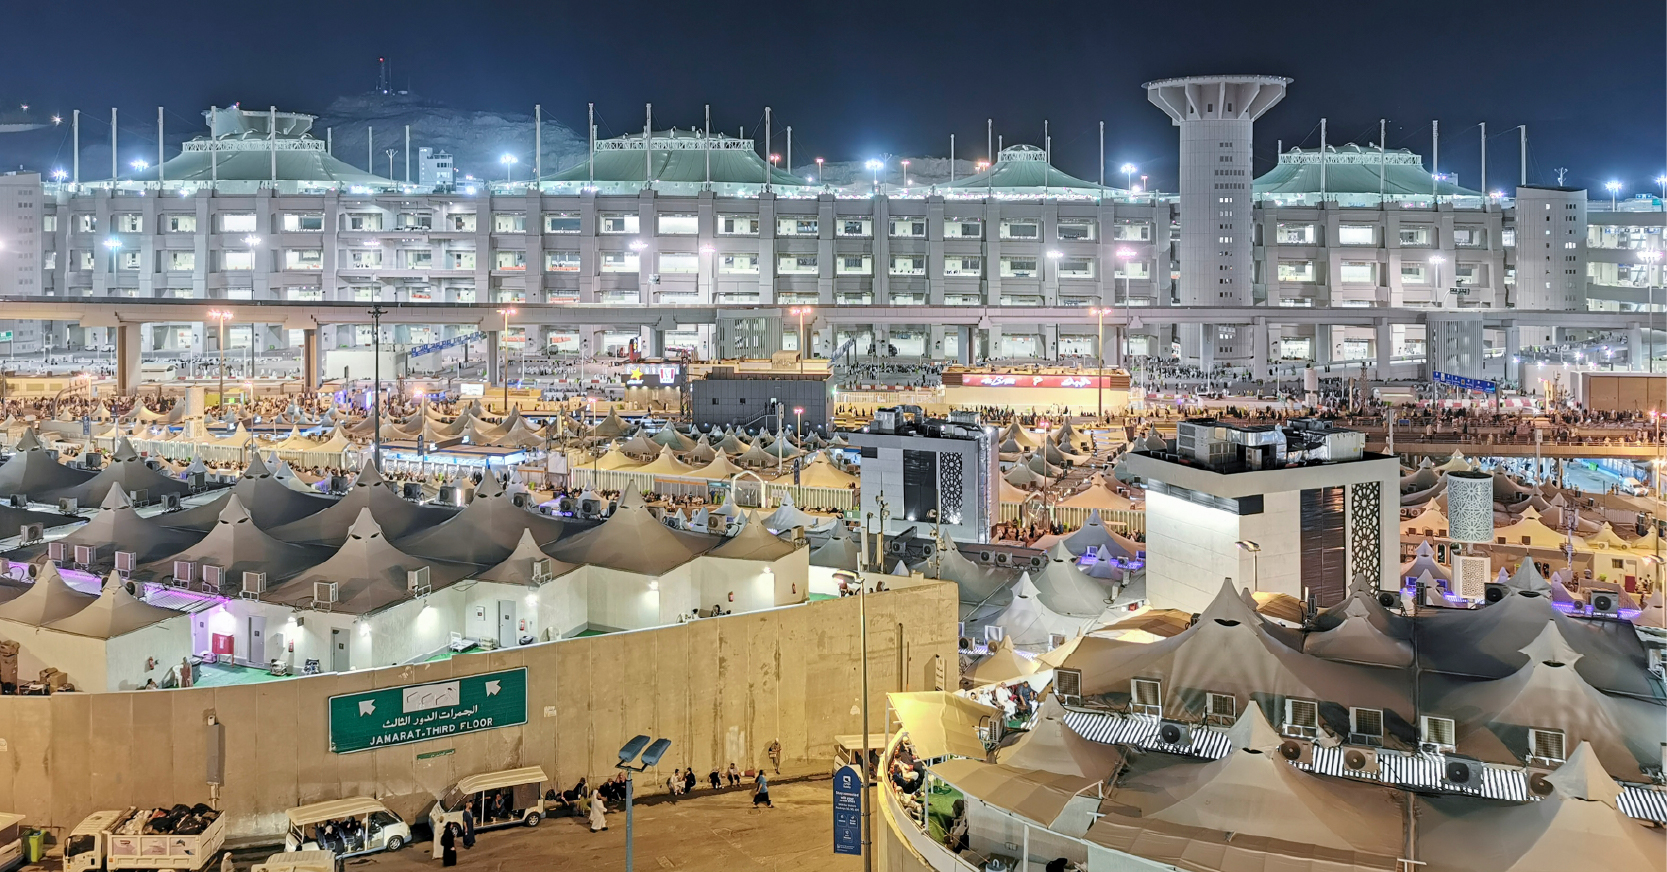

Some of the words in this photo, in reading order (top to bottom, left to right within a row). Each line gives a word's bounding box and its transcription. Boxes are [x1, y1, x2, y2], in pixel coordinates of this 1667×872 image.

[413, 711, 438, 725] الدور
[439, 704, 478, 720] الجمرات
[382, 715, 411, 729] الثالث
[460, 718, 493, 730] FLOOR
